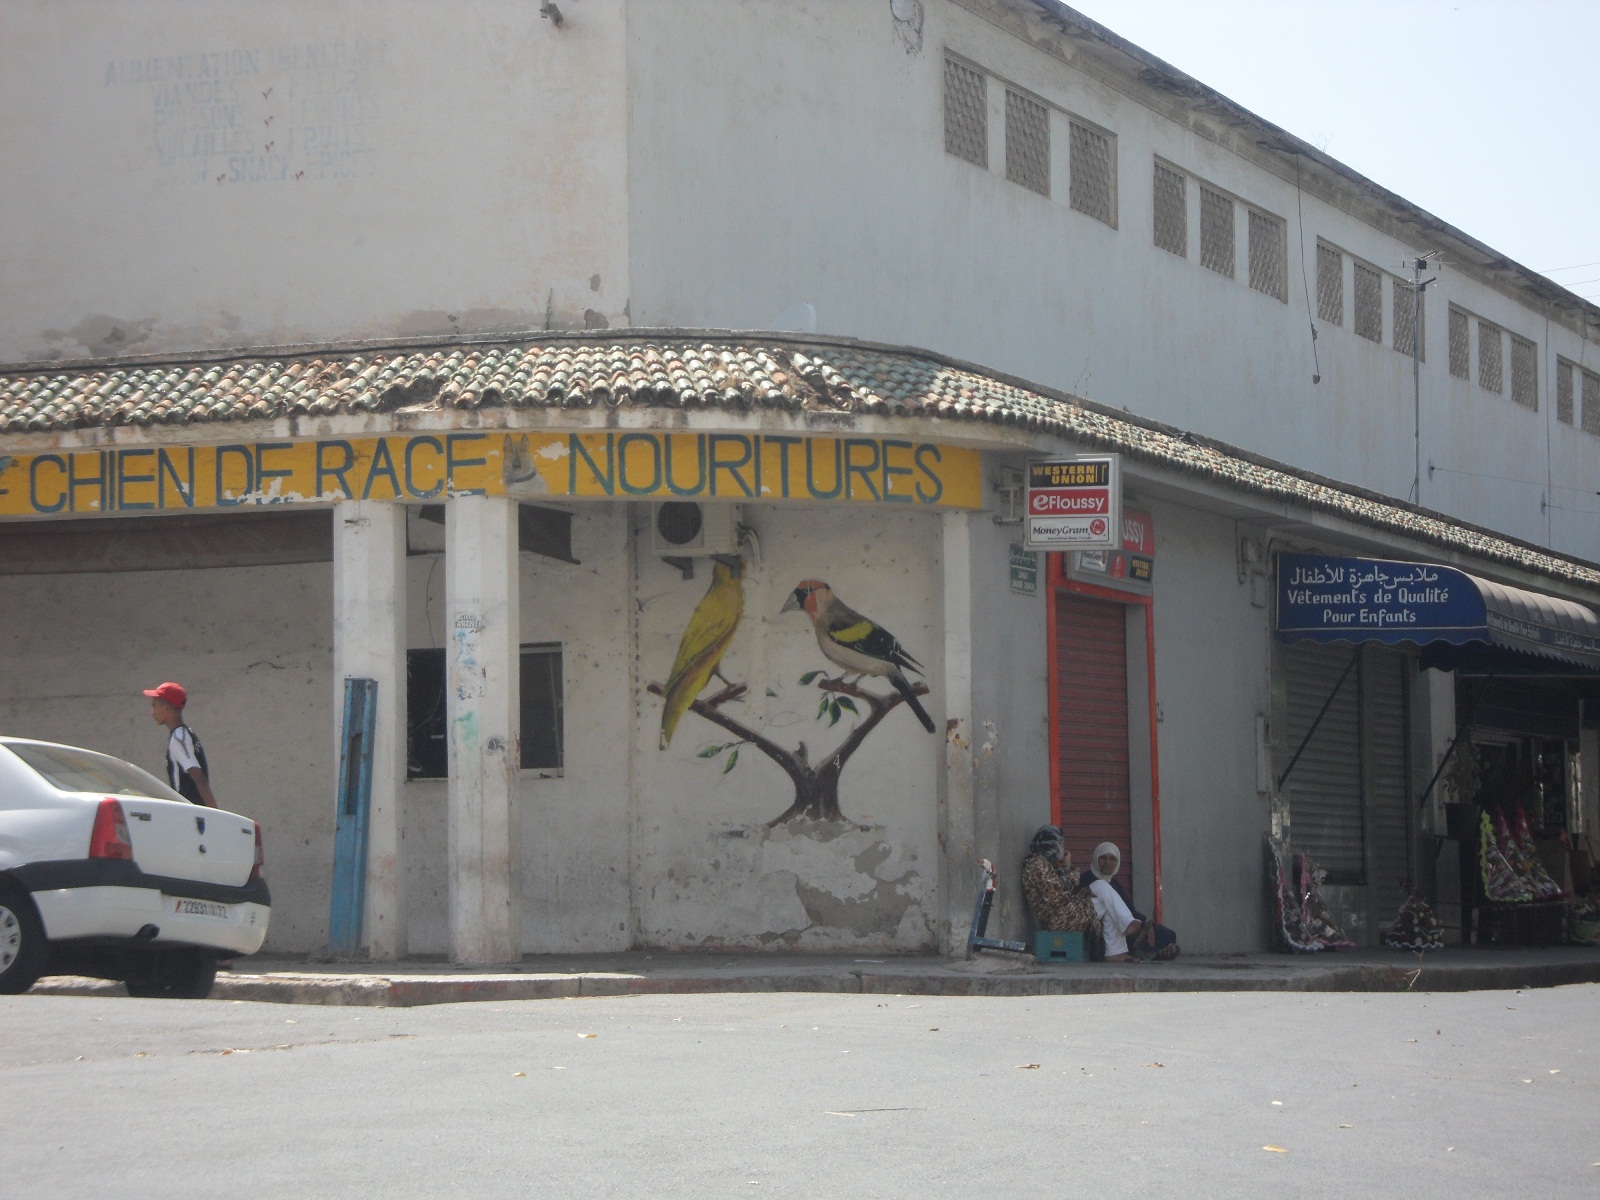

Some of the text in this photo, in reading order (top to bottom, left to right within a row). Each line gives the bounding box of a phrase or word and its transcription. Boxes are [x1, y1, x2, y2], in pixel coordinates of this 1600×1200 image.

[30, 433, 943, 513] CHIEN DE RACE NOURITURES
[1033, 464, 1095, 476] WESTERN
[1051, 474, 1096, 484] UNION
[1033, 494, 1105, 511] eFloussy
[1032, 525, 1089, 536] MoneyGram
[1289, 564, 1439, 589] ملابس جاهزة للأطفال
[1287, 587, 1449, 605] Vêtements de Qualité
[1323, 608, 1417, 627] Pour Enfants
